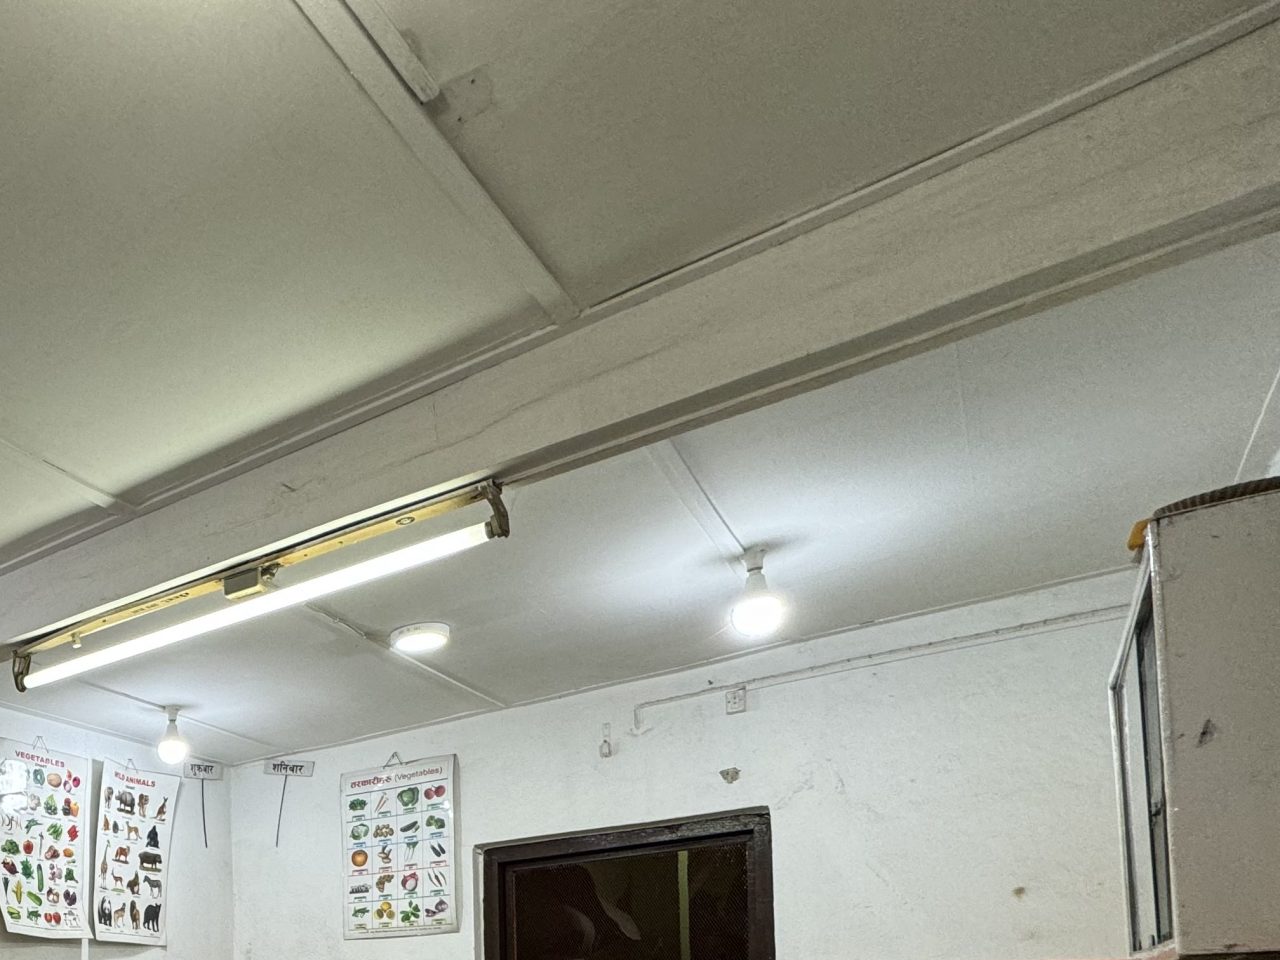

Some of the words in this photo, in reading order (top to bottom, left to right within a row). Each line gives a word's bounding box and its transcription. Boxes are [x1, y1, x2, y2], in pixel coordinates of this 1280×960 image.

[15, 750, 65, 768] VEGETABLES
[126, 775, 156, 788] ANIMALS
[394, 767, 443, 783] (Vegetables)
